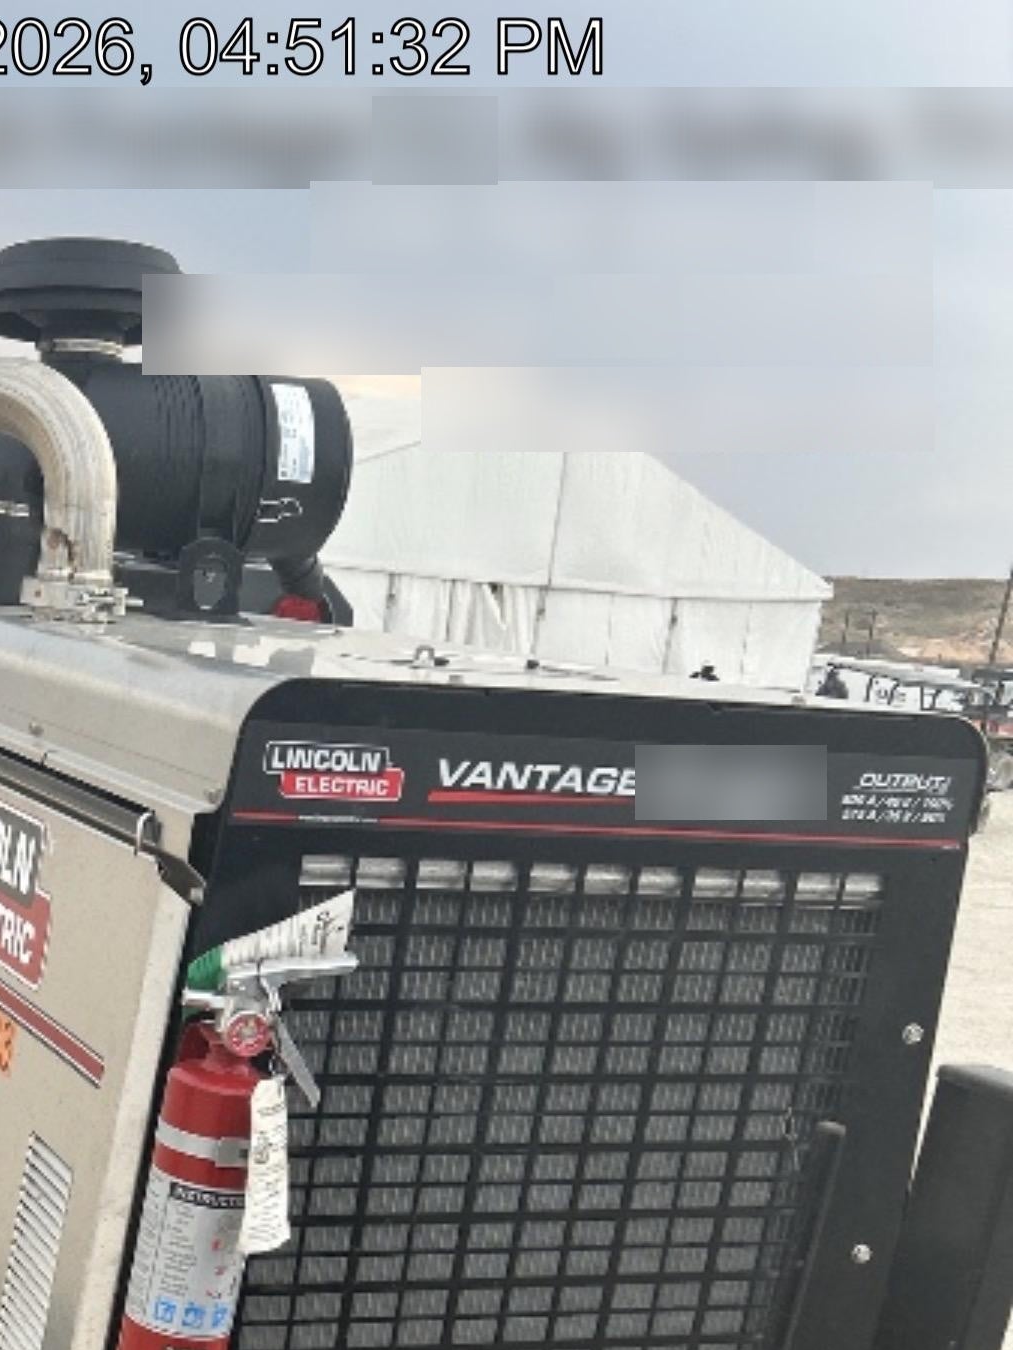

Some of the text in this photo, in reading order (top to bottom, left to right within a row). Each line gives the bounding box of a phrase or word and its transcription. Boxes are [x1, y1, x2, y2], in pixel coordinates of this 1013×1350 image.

[271, 746, 381, 772] LINCOLN
[294, 775, 390, 796] ELECTRIC
[439, 758, 636, 796] VANTAGE
